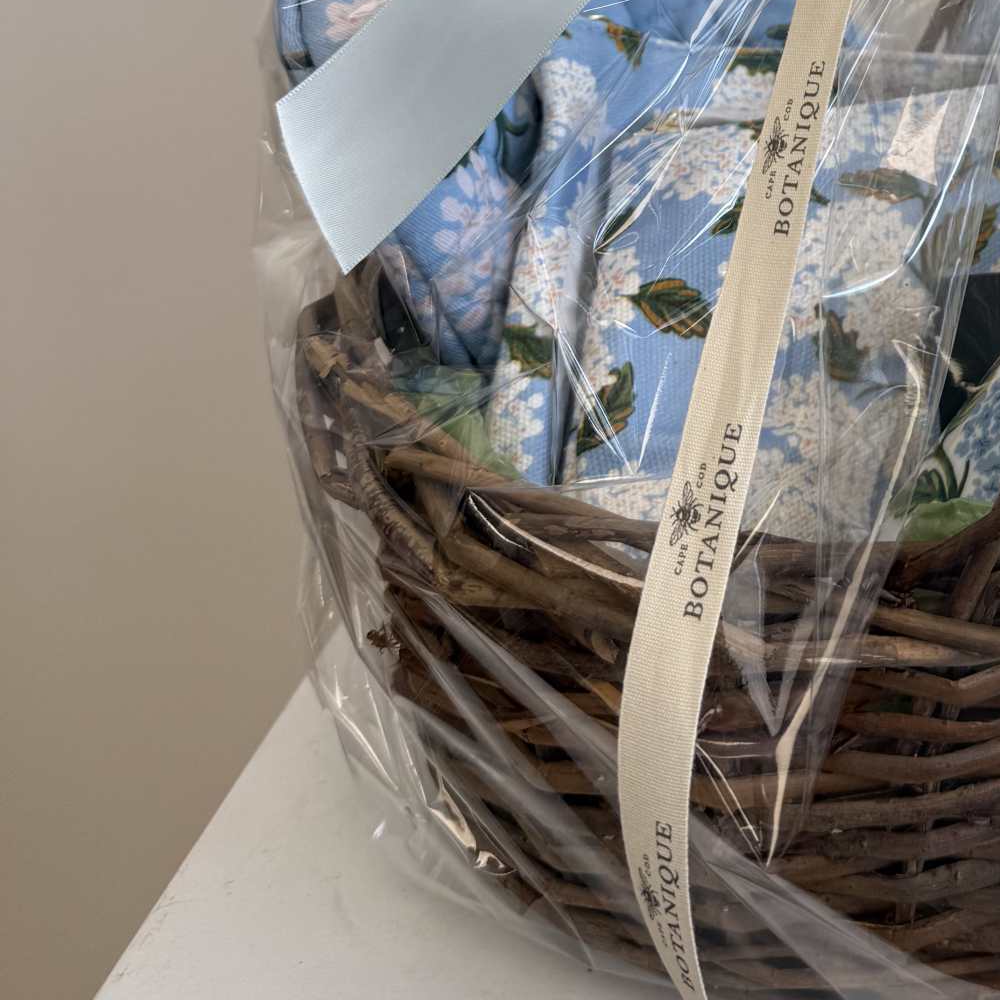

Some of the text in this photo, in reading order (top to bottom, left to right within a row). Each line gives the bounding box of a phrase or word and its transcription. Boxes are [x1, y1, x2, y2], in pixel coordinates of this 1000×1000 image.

[765, 98, 794, 199] CAPE COD
[774, 60, 826, 236] BOTANIQUE
[674, 462, 707, 576] CAPE COD
[683, 423, 743, 620] BOTANIQUE
[655, 820, 696, 992] BOTANIQUE
